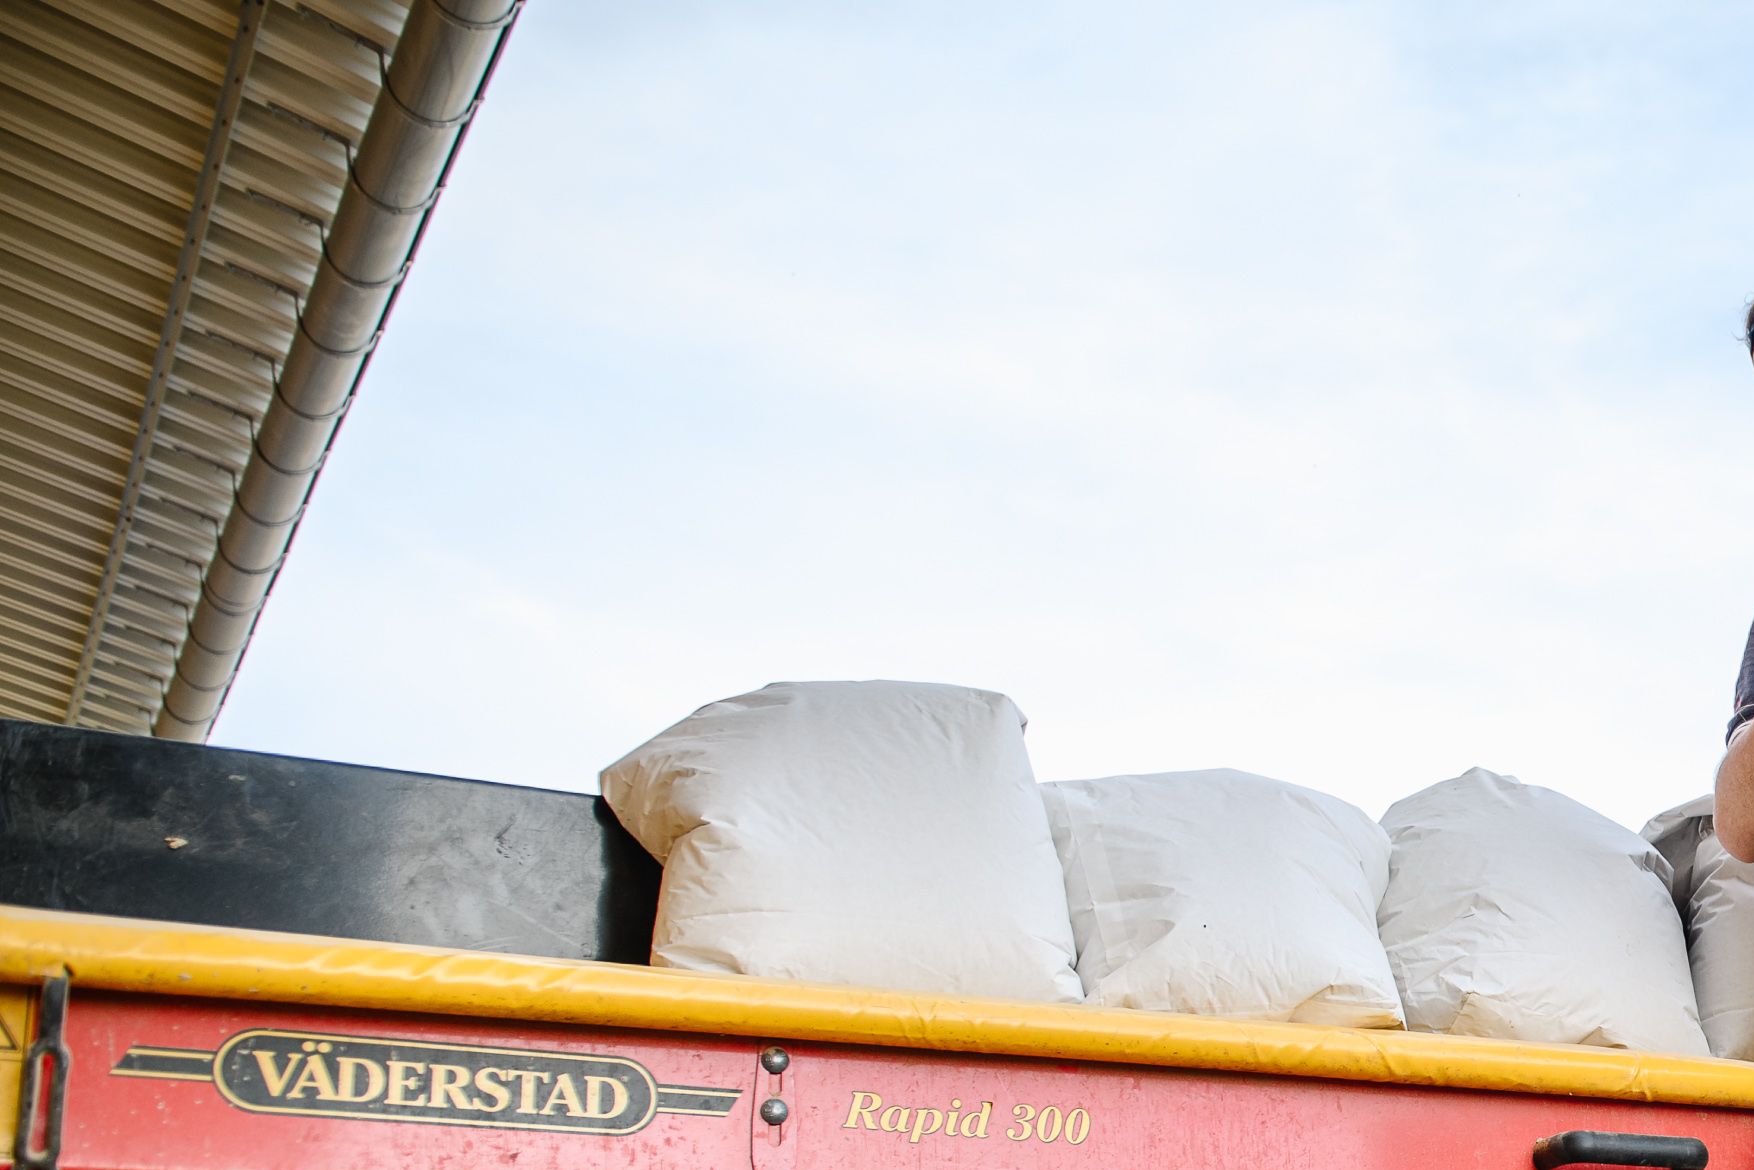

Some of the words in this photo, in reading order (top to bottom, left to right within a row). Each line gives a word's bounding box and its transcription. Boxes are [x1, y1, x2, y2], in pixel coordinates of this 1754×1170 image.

[252, 1040, 630, 1119] VÄDERSTAD
[841, 1090, 993, 1143] Rapid
[1006, 1103, 1091, 1145] 300
